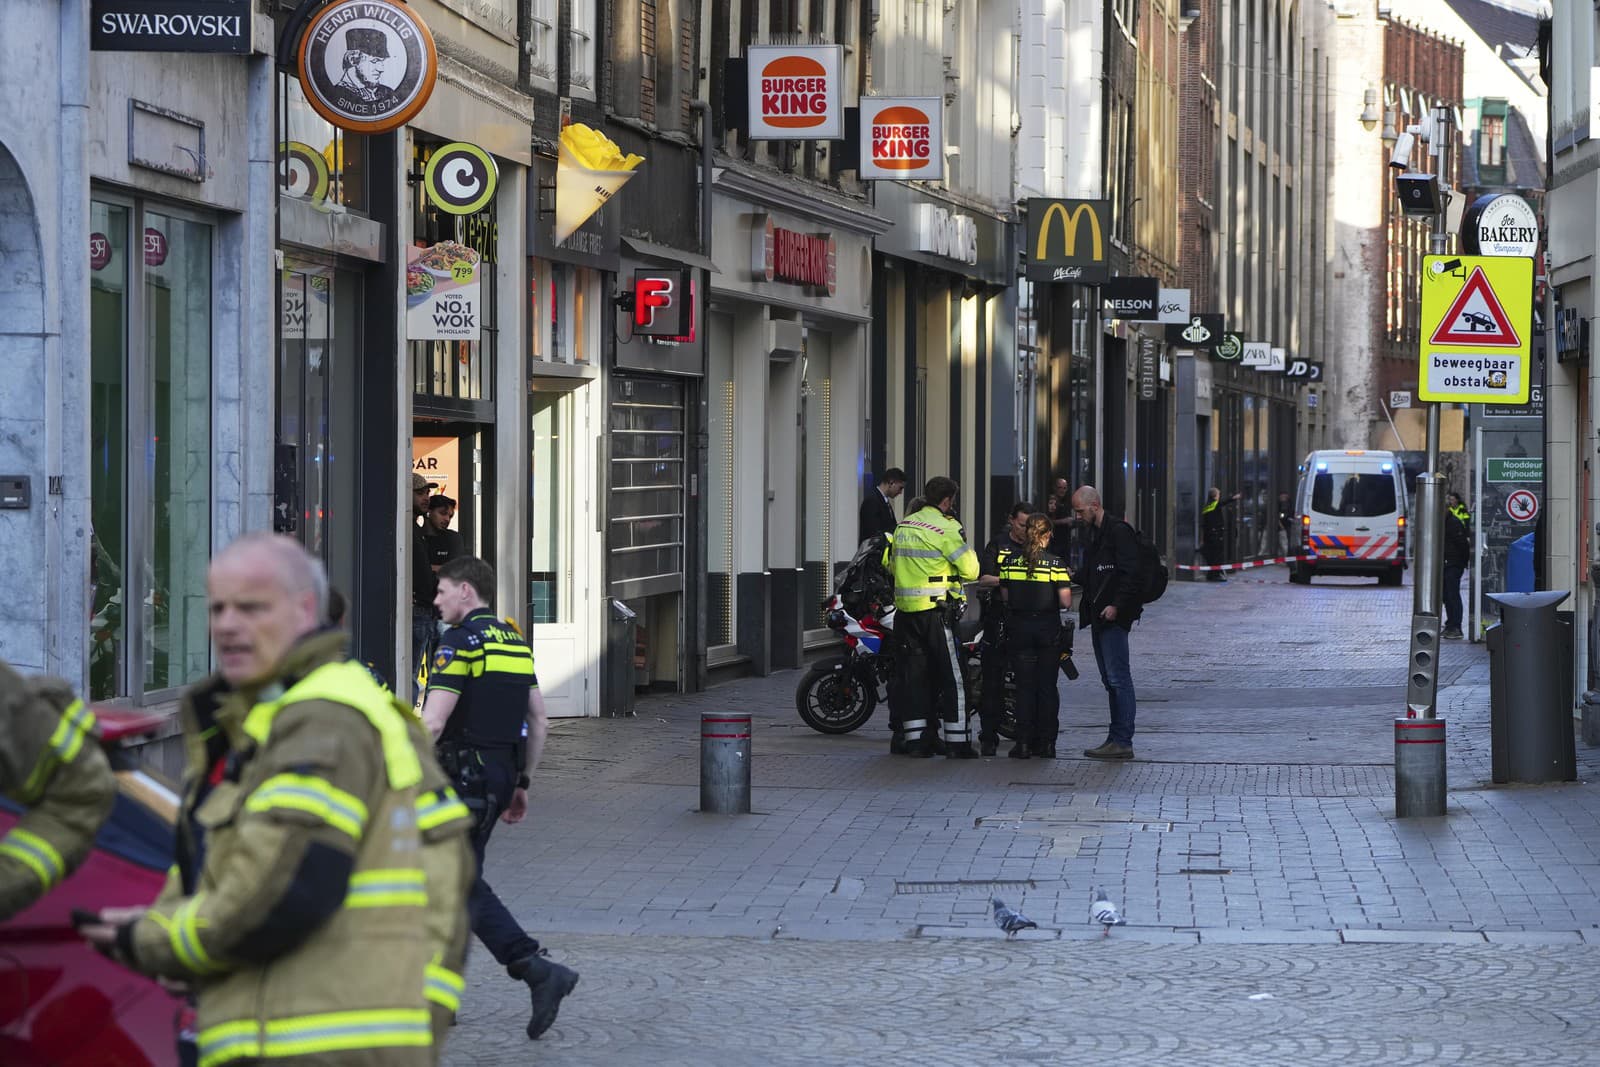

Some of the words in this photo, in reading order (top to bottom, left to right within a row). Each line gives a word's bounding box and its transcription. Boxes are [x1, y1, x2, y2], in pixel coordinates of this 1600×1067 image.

[101, 13, 241, 37] SWAROVSKI
[317, 5, 358, 43] HENRI
[364, 4, 413, 41] WILLIG
[762, 77, 826, 93] BURGER
[337, 96, 368, 114] SINCE
[371, 95, 400, 114] 1974
[762, 93, 827, 115] KING
[872, 124, 930, 140] BURGER
[872, 139, 930, 158] KING
[1481, 226, 1536, 242] BAKERY
[778, 228, 810, 282] BURGER
[1493, 243, 1523, 254] Company
[435, 301, 472, 314] NO.1
[635, 277, 673, 328] F
[1104, 299, 1153, 309] NELSON
[432, 315, 475, 328] WOK
[1143, 339, 1154, 398] MANFIELD
[1287, 361, 1308, 376] JD
[1433, 356, 1515, 372] beweegbaar
